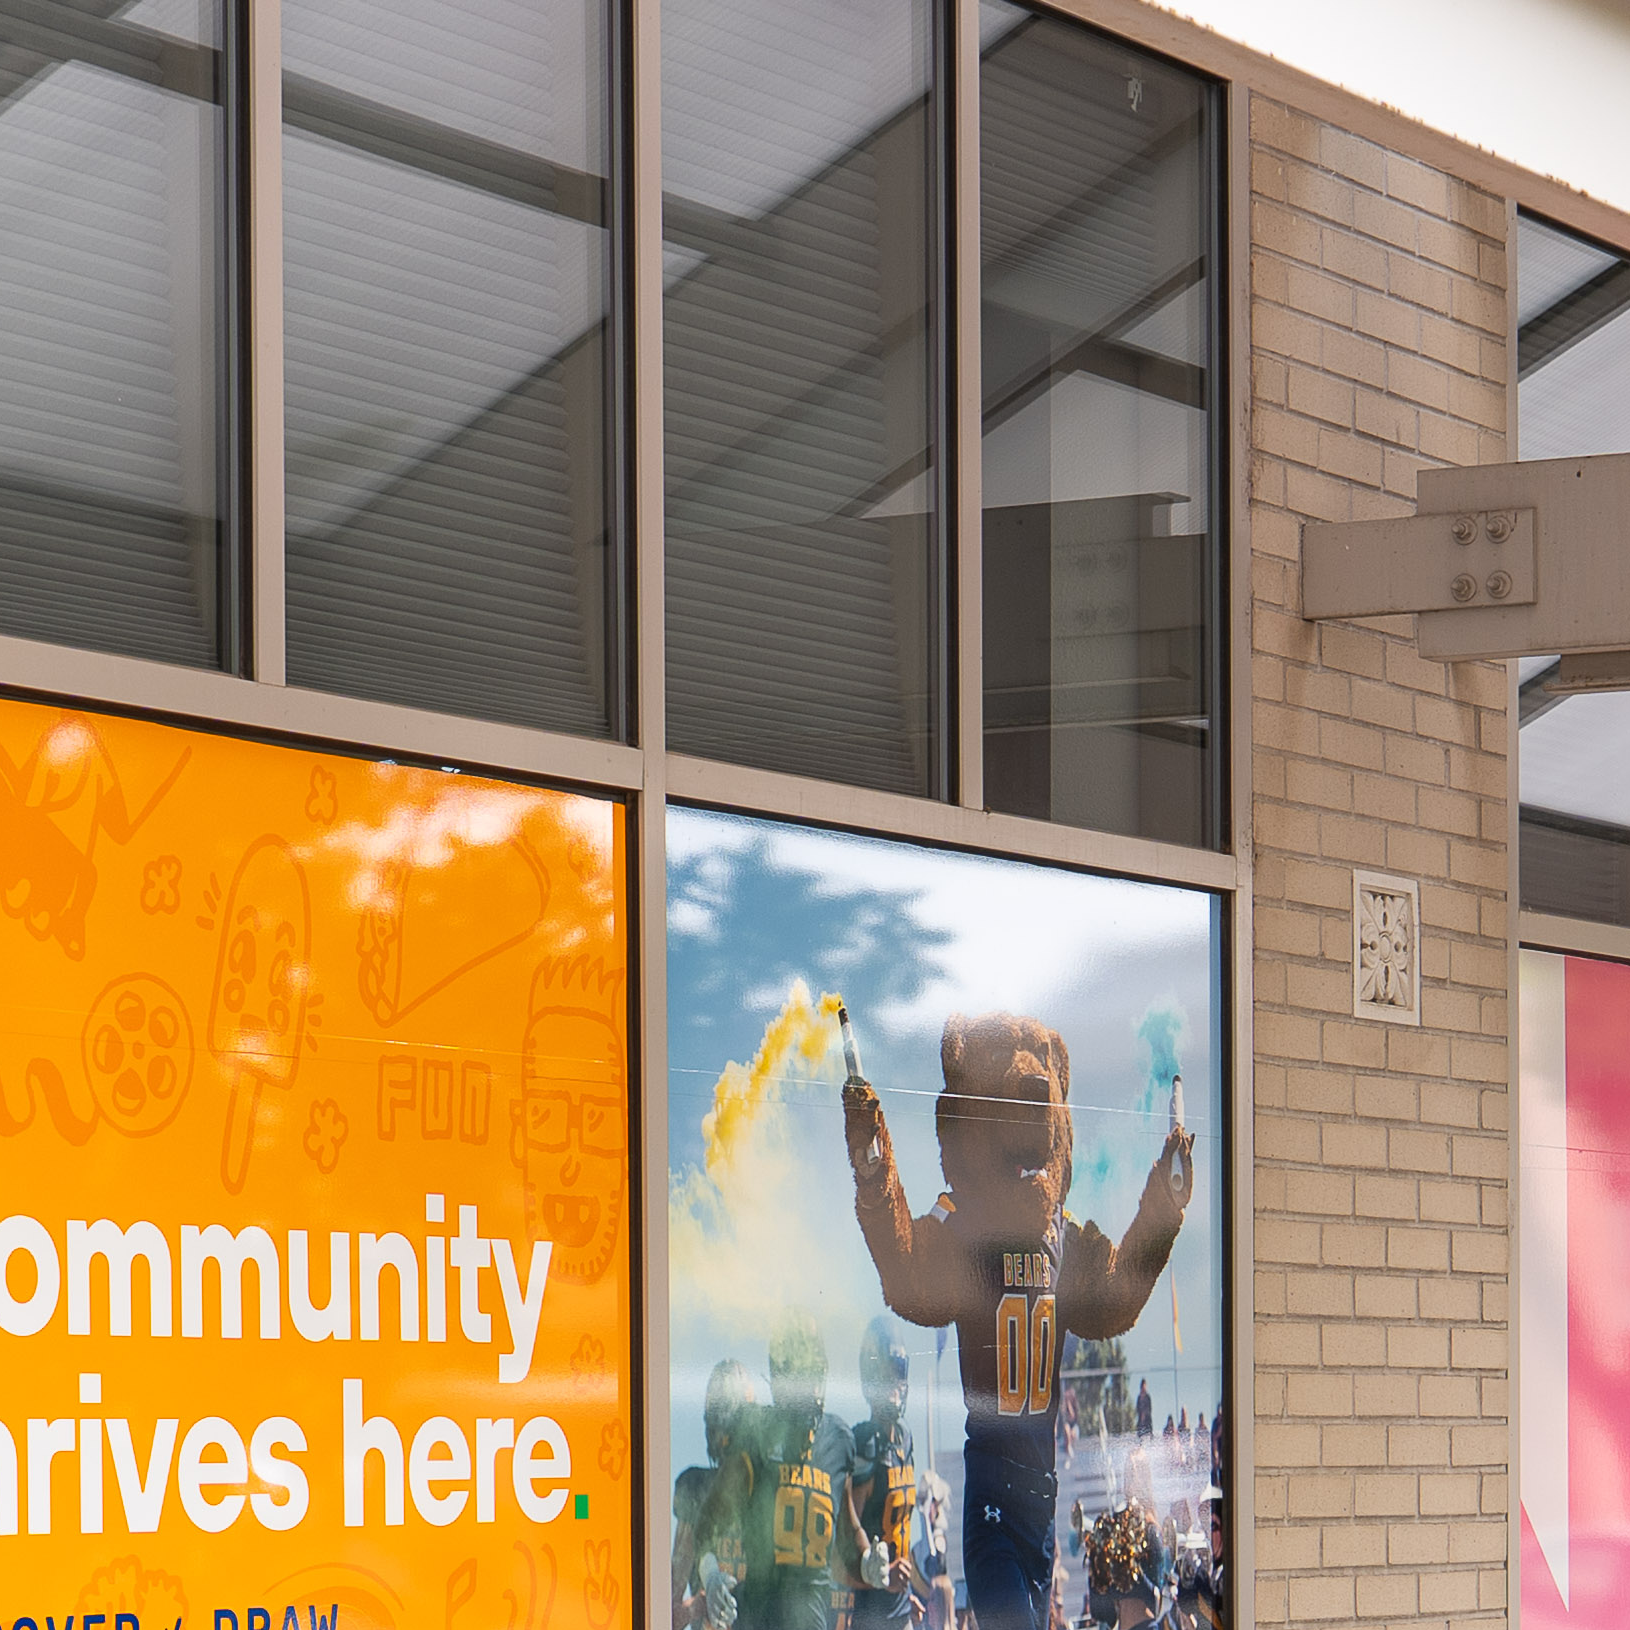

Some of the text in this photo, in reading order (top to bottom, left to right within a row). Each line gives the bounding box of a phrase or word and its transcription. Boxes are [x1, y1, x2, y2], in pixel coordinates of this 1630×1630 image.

[1003, 1253, 1051, 1288] BEARS
[996, 1293, 1056, 1417] 00
[343, 1378, 589, 1529] here.
[778, 1464, 832, 1495] BEARS
[773, 1486, 833, 1568] 98
